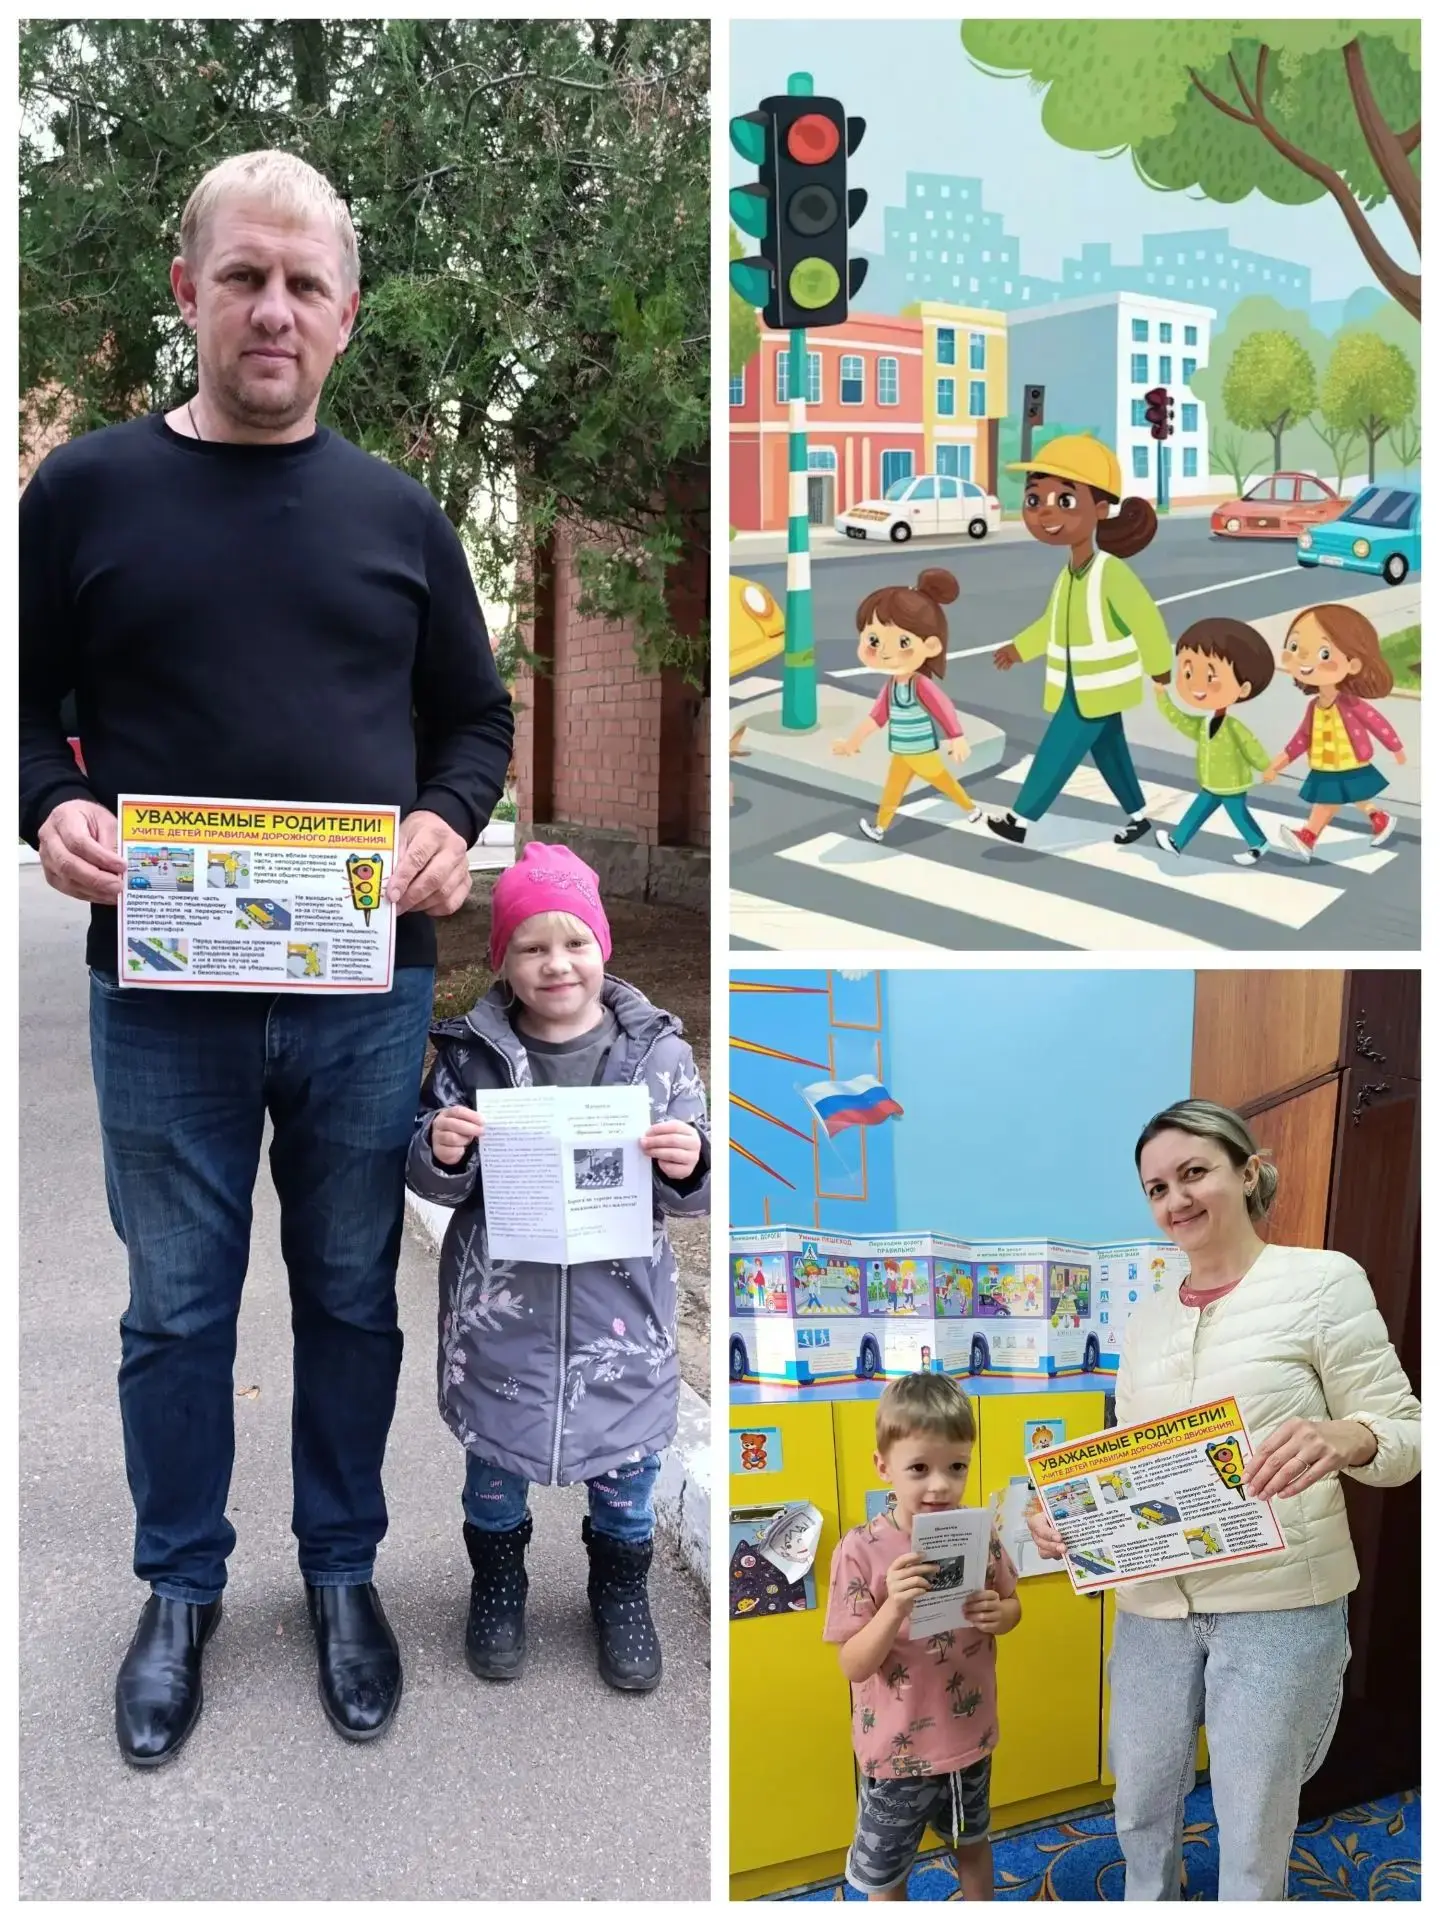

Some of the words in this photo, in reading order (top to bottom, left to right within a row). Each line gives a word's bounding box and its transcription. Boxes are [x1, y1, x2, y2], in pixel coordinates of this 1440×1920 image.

[131, 826, 164, 836] УЧИТЕ
[167, 827, 200, 837] ДЕТЕЙ
[205, 829, 259, 840] ПРАВИЛАМ
[261, 831, 325, 842] ДОРОЖНОГО
[328, 834, 386, 845] ДВИЖЕНИЯ!
[136, 809, 265, 828] УВАЖАЕМЫЕ
[272, 814, 381, 833] РОДИТЕЛИ!
[1039, 1435, 1131, 1471] УВАЖАЕМЫЕ
[1133, 1406, 1227, 1443] РОДИТЕЛИ!
[1041, 1469, 1064, 1481] УЧИТЕ
[1063, 1462, 1088, 1474] ДЕТЕЙ
[1089, 1450, 1129, 1467] ПРАВИЛАМ
[1129, 1434, 1182, 1455] ДОРОЖНОГО
[1182, 1419, 1235, 1440] ДВИЖЕНИЯ!
